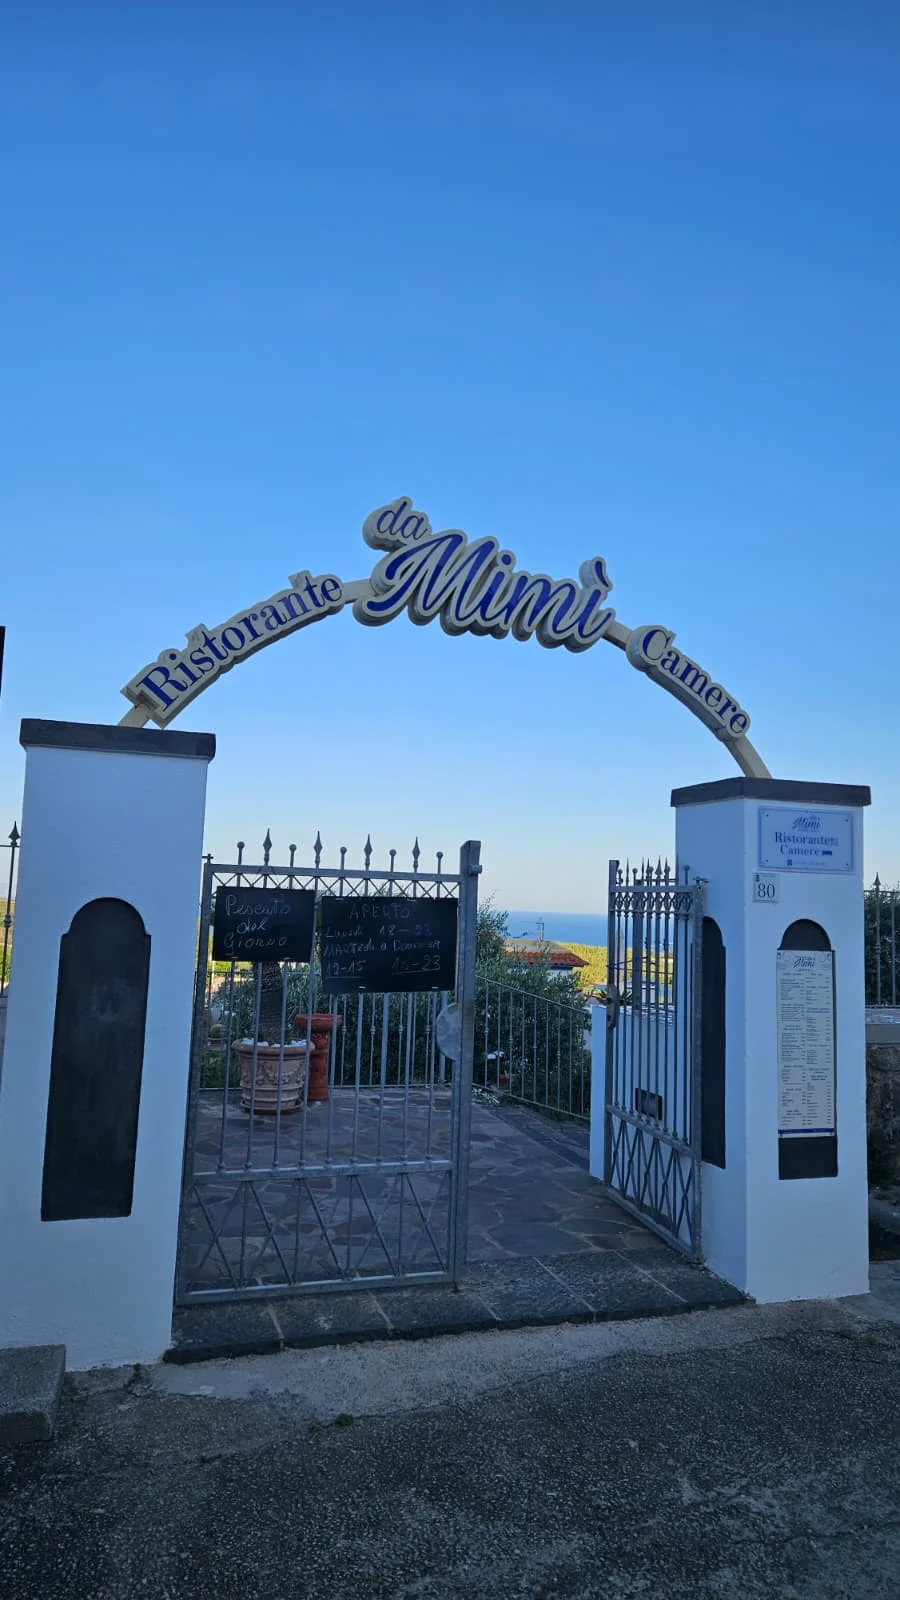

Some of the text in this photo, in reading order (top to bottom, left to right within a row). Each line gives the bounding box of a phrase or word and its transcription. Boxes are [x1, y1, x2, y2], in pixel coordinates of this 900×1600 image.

[376, 500, 427, 541] da
[365, 533, 613, 640] Mimì
[135, 573, 344, 714] Ristorante
[640, 627, 750, 736] Camere
[774, 831, 832, 847] Ristorante
[780, 844, 821, 857] Camere
[757, 882, 776, 899] 80
[349, 902, 411, 921] APERTO
[236, 918, 269, 935] del
